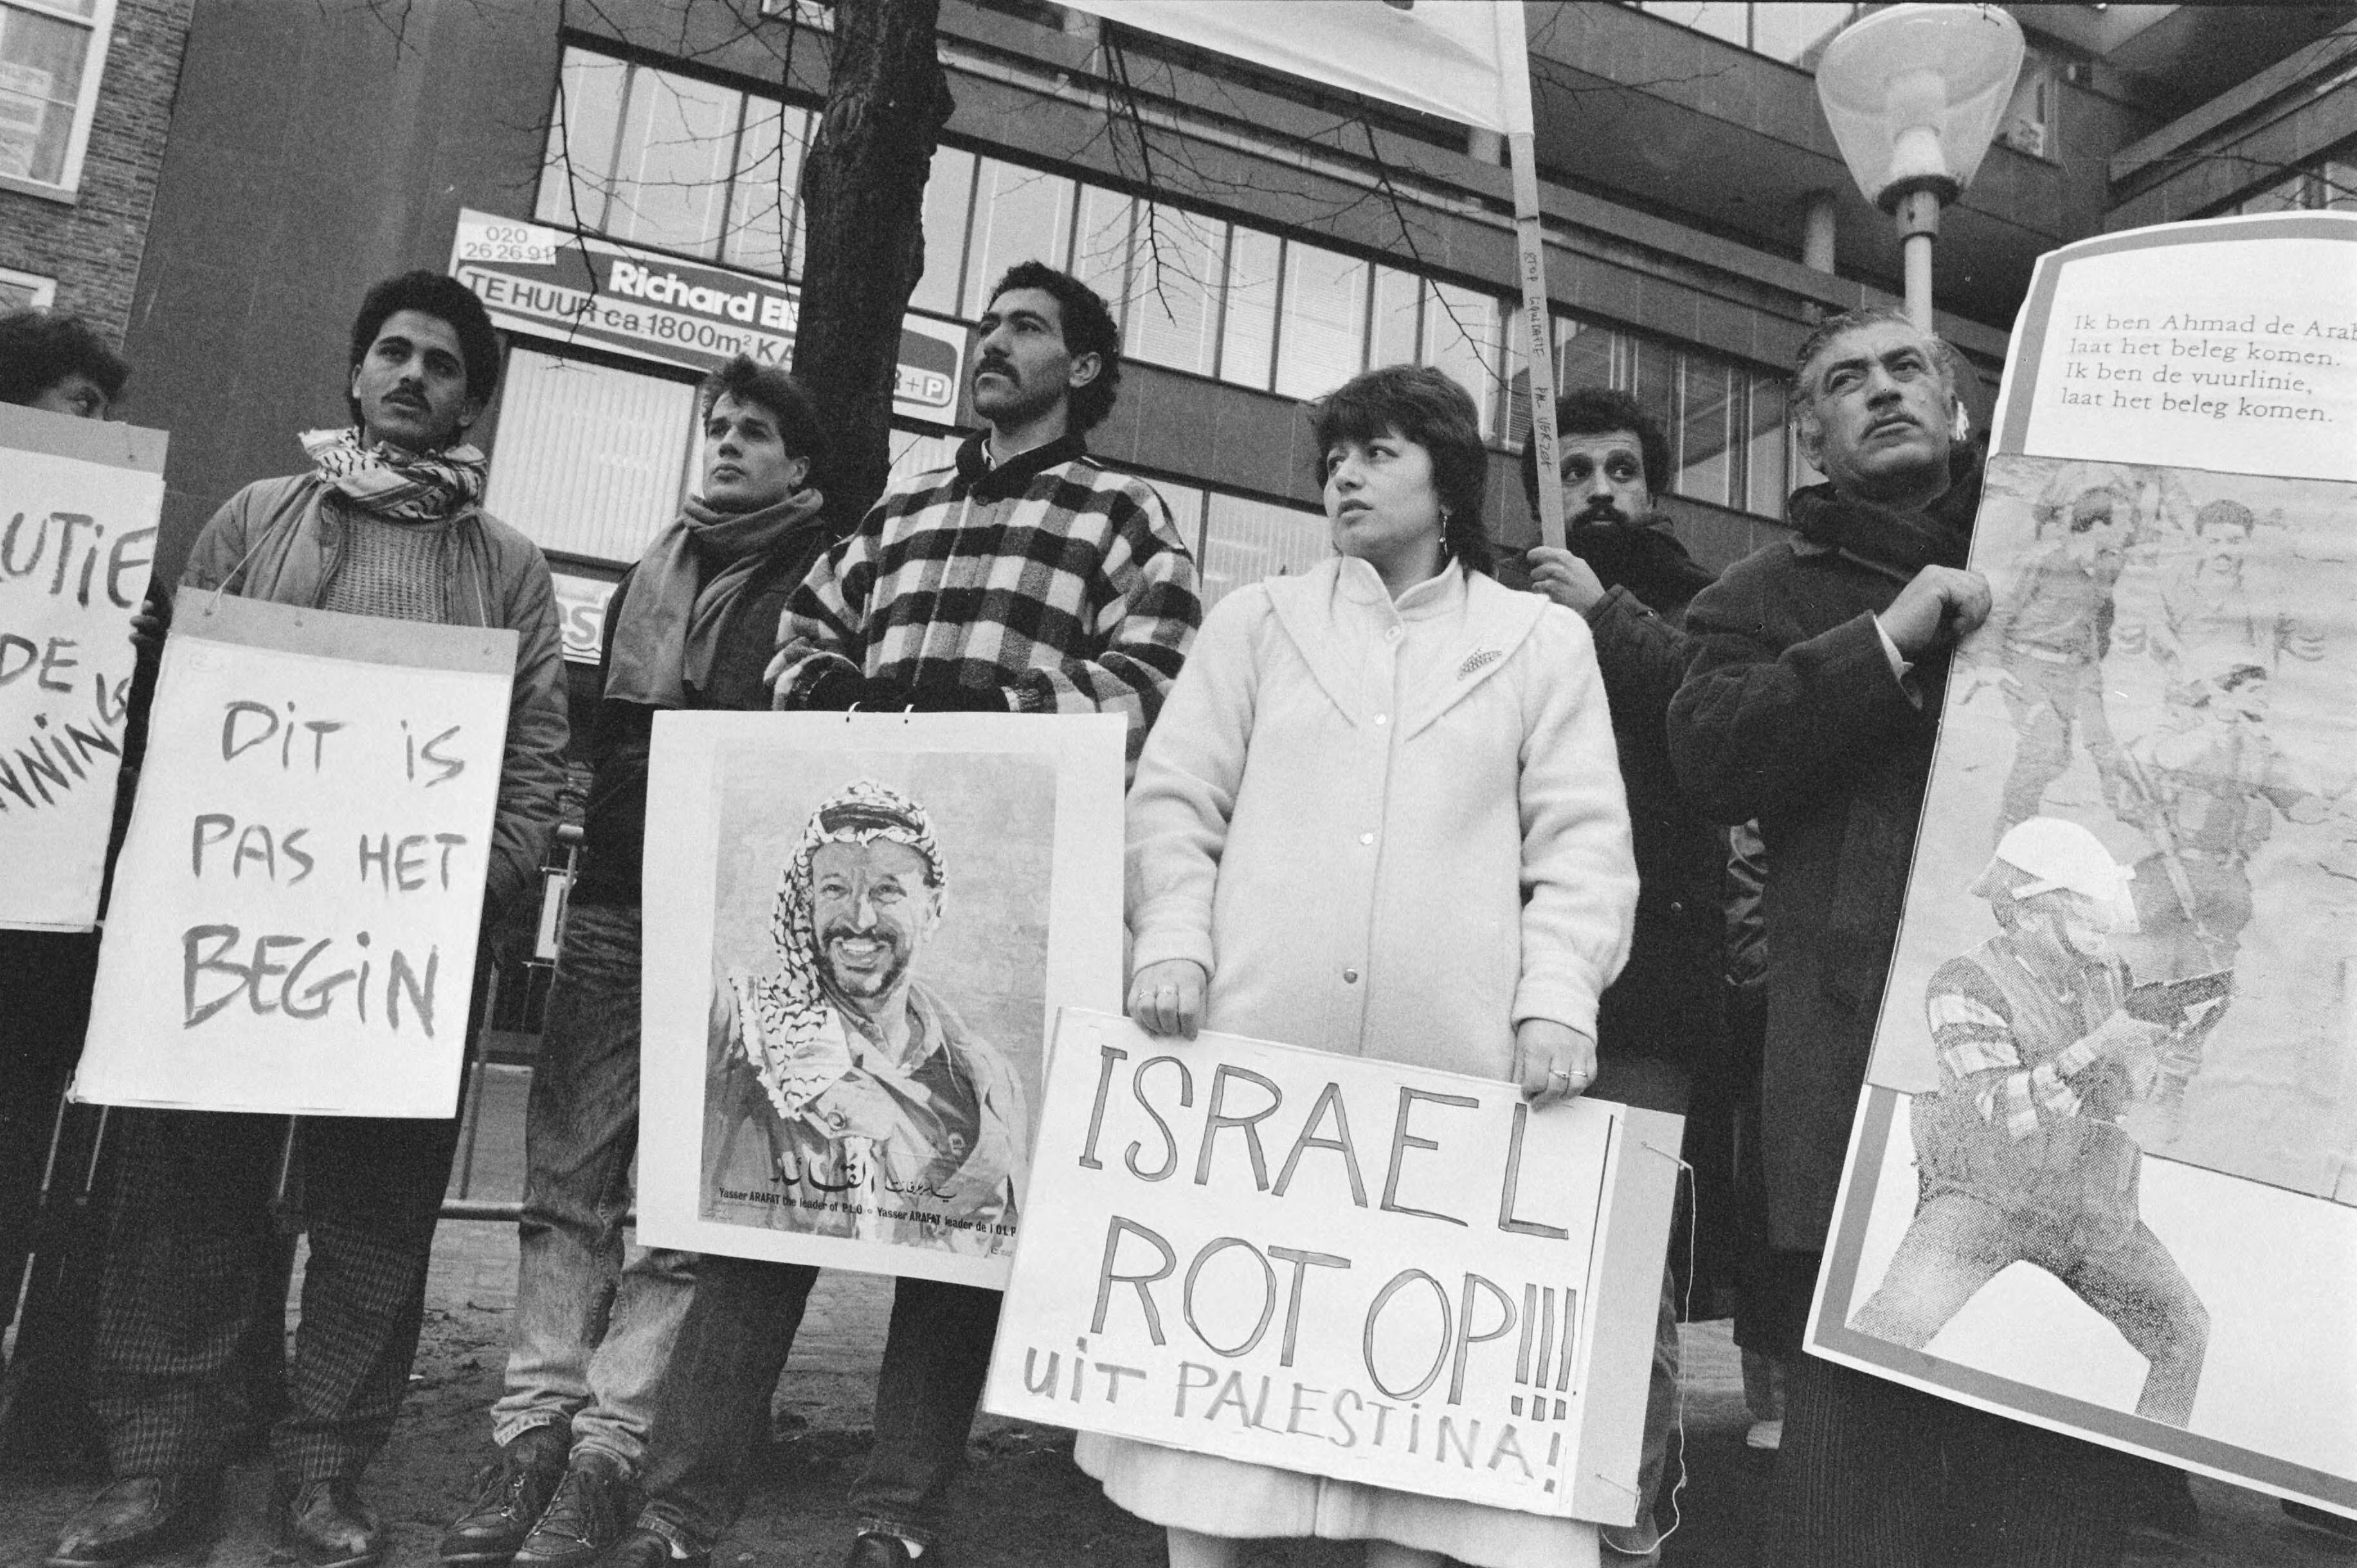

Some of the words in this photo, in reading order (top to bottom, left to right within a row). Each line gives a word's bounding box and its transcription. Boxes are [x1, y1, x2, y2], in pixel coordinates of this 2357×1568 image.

[465, 242, 492, 258] 26
[497, 244, 523, 260] 26
[485, 226, 528, 244] 020
[466, 271, 507, 302] TE
[510, 282, 597, 322] HUUR
[609, 260, 757, 323] Richard
[2073, 314, 2096, 330] Ik
[2106, 313, 2151, 330] ben
[2158, 313, 2255, 332] Ahmad
[2264, 314, 2295, 335] de
[2069, 338, 2113, 354] laat
[2120, 337, 2161, 355] het
[2170, 338, 2238, 363] beleg
[2247, 341, 2341, 366] komen.
[2066, 361, 2089, 379] Ik
[2097, 361, 2142, 381] ben
[2152, 364, 2182, 384] de
[2190, 369, 2313, 395] vuurlinie,
[2061, 386, 2104, 407] laat
[2111, 389, 2153, 410] het
[2161, 391, 2229, 419] beleg
[2237, 396, 2333, 422] komen.
[192, 813, 315, 886] PAS
[359, 832, 467, 893] HET
[1078, 1044, 1569, 1240] ISRAEL
[719, 1187, 748, 1201] Yasser
[748, 1191, 781, 1205] ARAFAT
[782, 1194, 797, 1207] the
[799, 1198, 827, 1211] leader
[829, 1202, 839, 1212] of
[877, 1207, 908, 1221] Yasser
[909, 1211, 942, 1225] ARAFAT
[944, 1216, 973, 1230] leader
[976, 1221, 987, 1233] de
[1090, 1214, 1351, 1367] ROT
[1362, 1268, 1577, 1422] OP!!!
